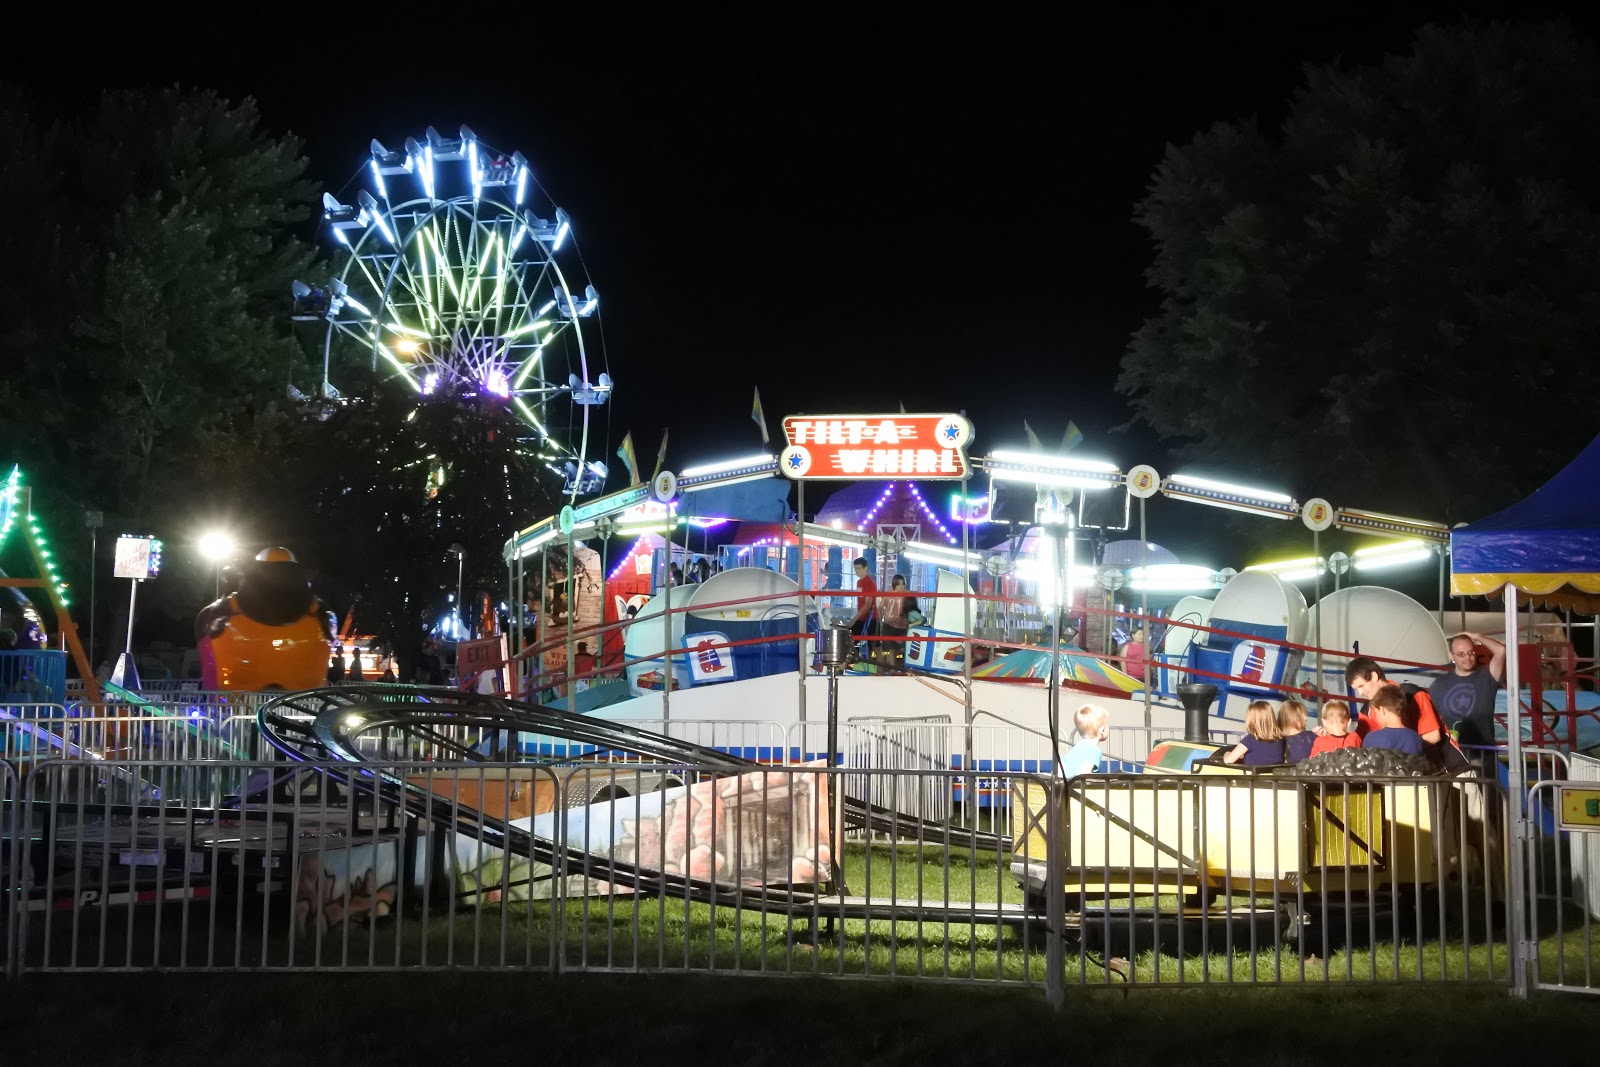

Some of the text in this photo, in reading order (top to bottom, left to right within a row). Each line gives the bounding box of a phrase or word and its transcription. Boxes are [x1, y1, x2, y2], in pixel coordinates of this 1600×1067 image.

[838, 449, 958, 473] WHIRL
[888, 598, 902, 618] 21
[467, 645, 490, 664] EXIT
